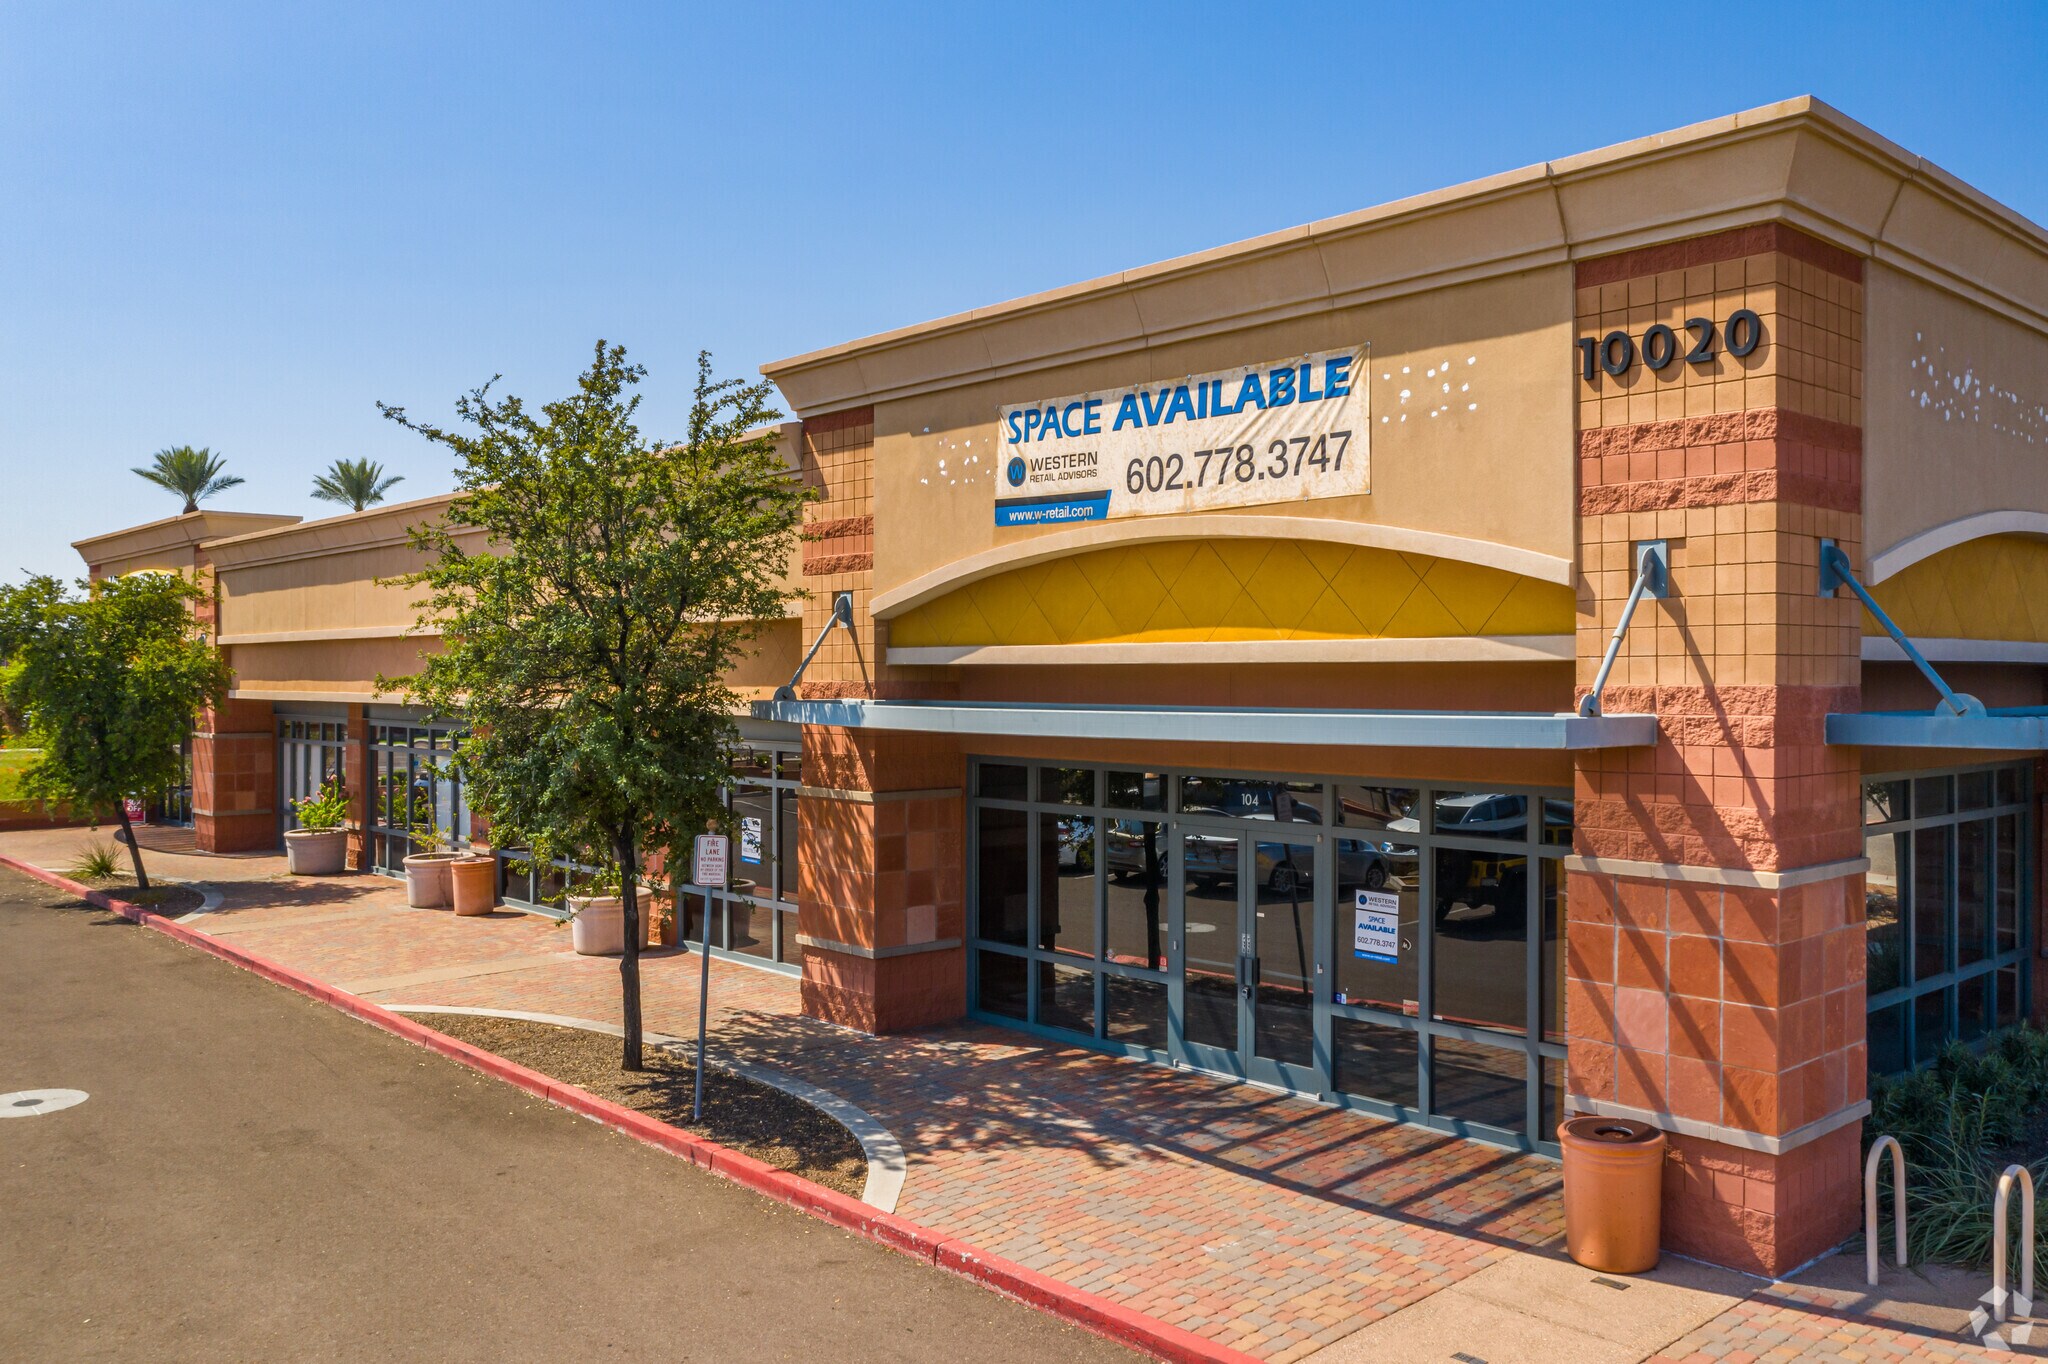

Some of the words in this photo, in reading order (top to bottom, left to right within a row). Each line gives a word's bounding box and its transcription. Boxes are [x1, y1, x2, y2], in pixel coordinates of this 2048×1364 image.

[1577, 308, 1761, 381] 10020
[1008, 399, 1102, 444] SPACE
[1112, 356, 1352, 432] AVAILABLE
[1030, 451, 1098, 472] WESTERN
[1126, 430, 1352, 495] 602.778.3747
[1030, 474, 1055, 483] RETAIL
[1058, 469, 1098, 481] ADVISORS
[1009, 506, 1094, 521] www.w-retail.com
[1241, 793, 1259, 806] 104
[1369, 896, 1397, 905] WESTERN
[1368, 916, 1385, 924] SPACE
[1358, 923, 1396, 934] AVAILABLE
[1357, 936, 1396, 948] 602.778.3747
